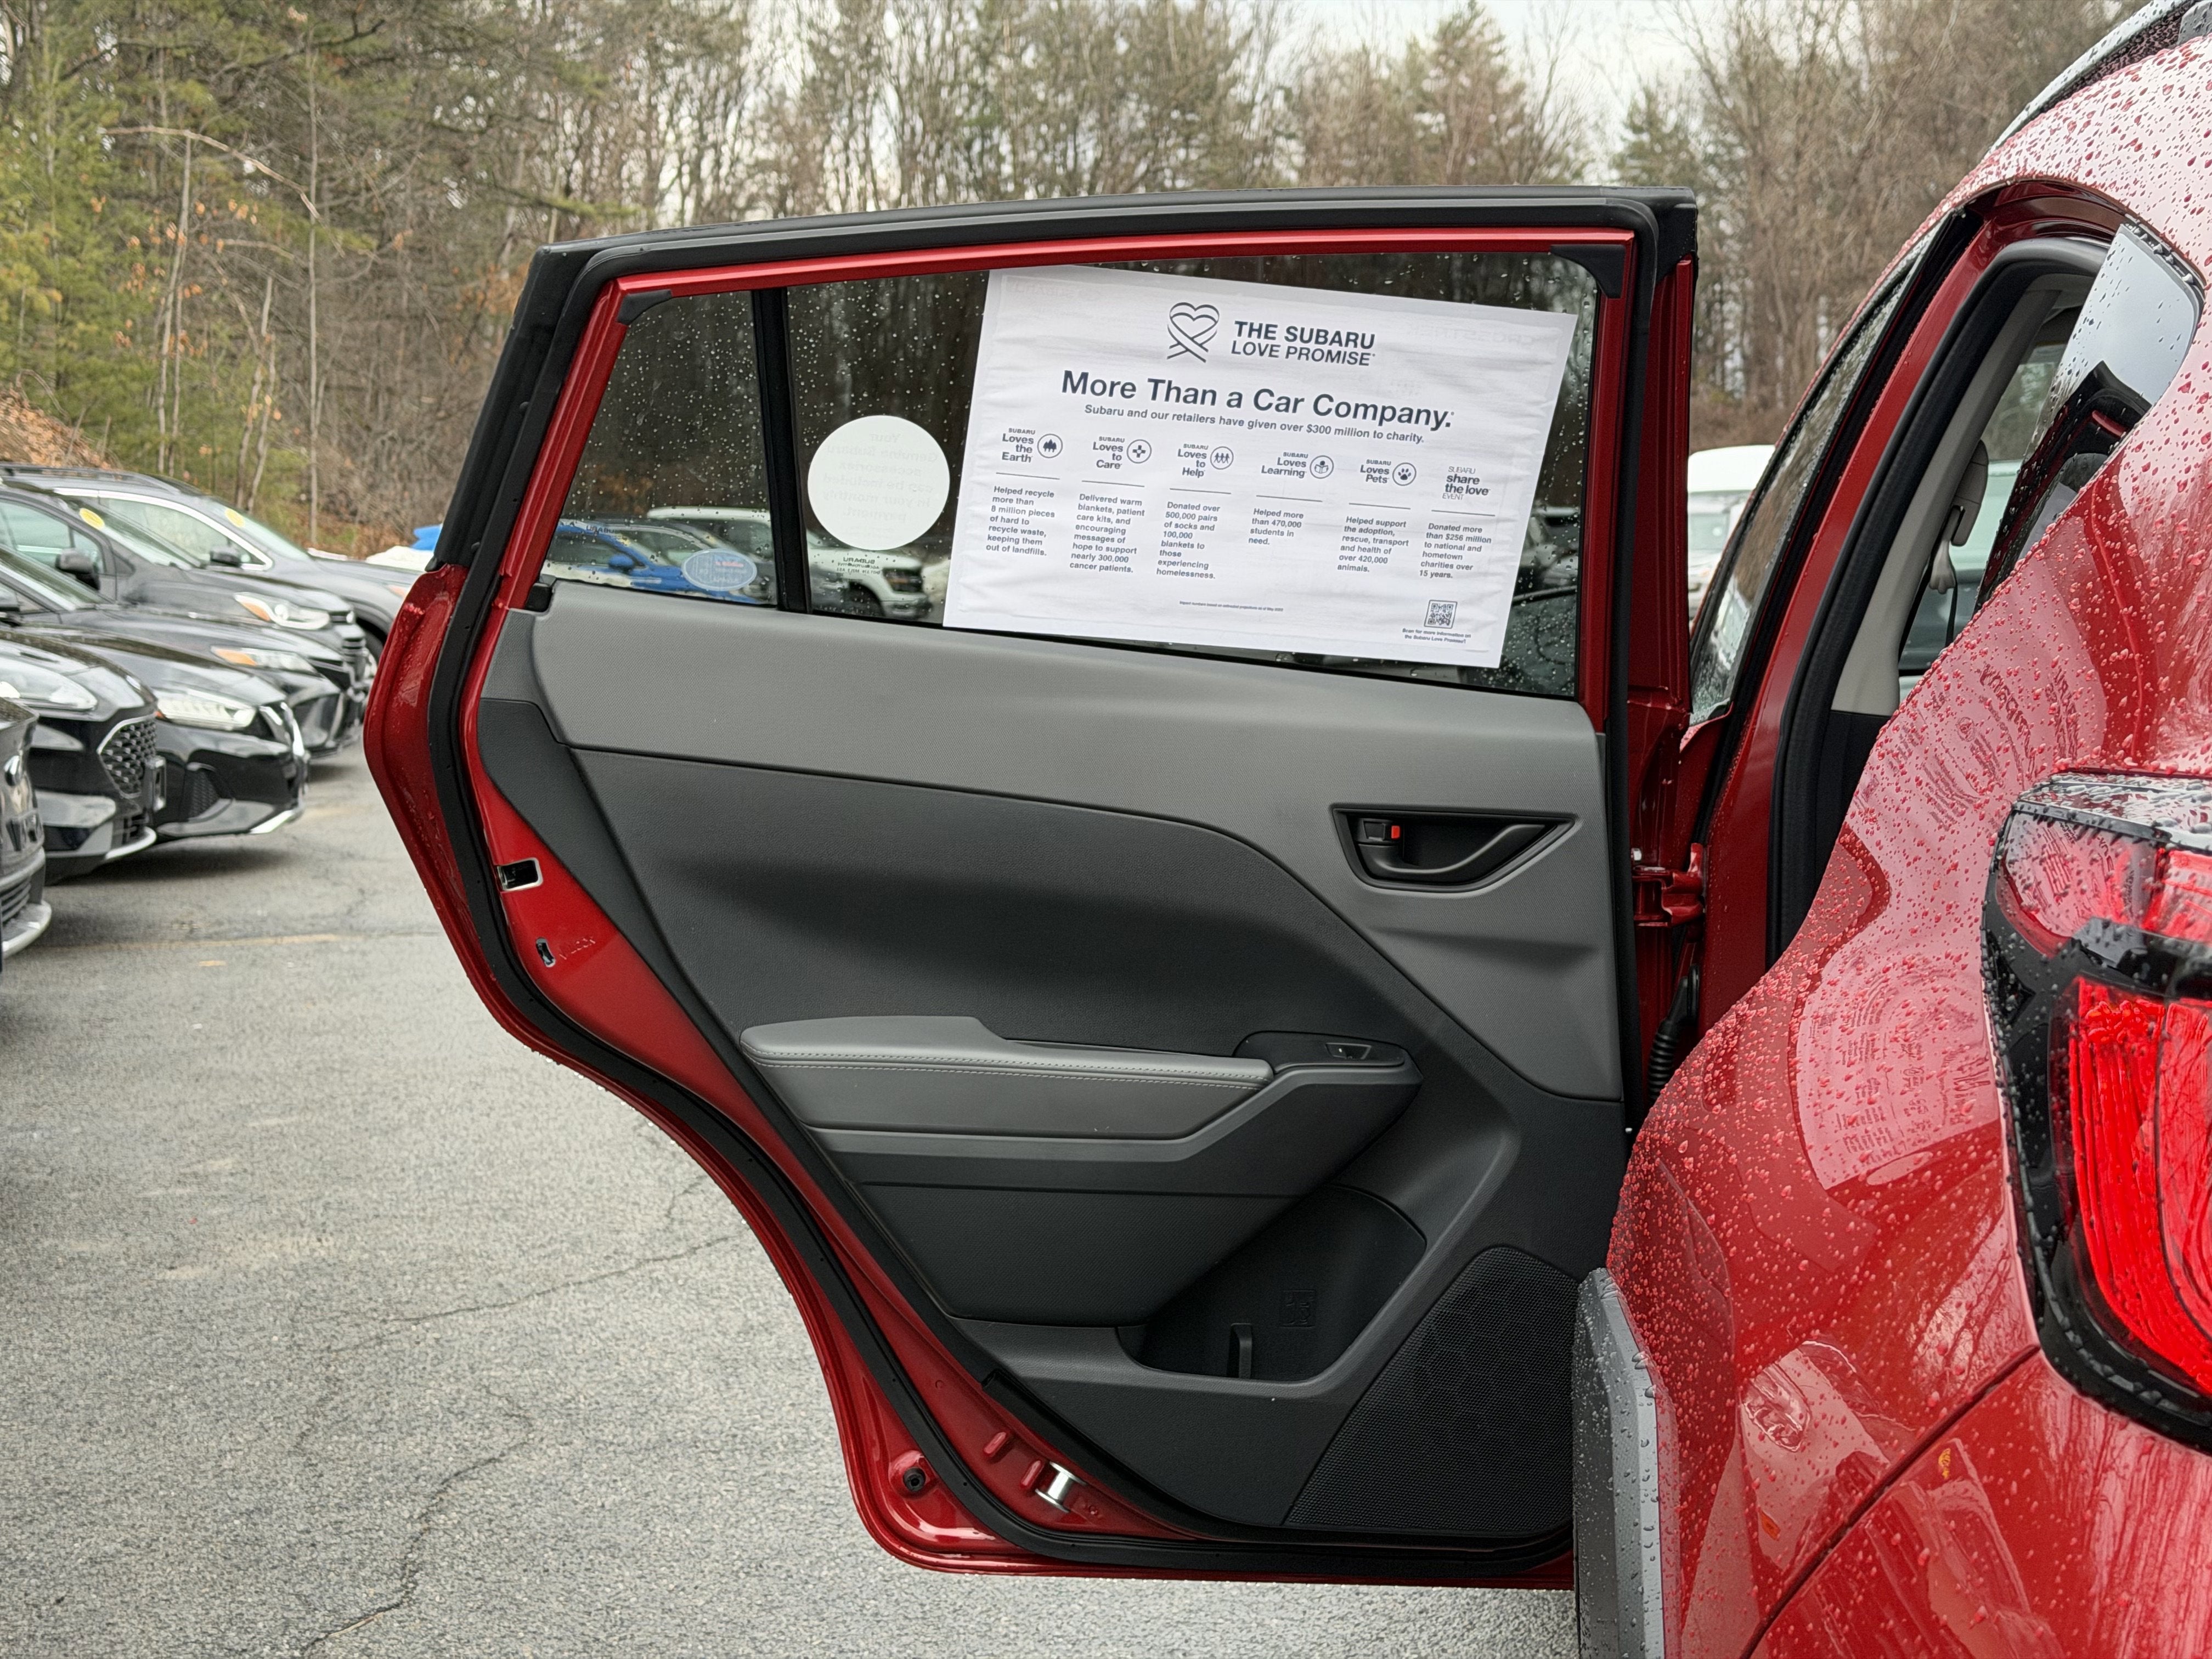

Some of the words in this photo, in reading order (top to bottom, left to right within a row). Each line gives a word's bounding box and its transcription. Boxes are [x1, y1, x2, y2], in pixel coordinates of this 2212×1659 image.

[1234, 320, 1278, 341] THE
[1284, 325, 1375, 350] SUBARU
[1231, 340, 1281, 358] LOVE
[1062, 370, 1137, 399] More
[1147, 378, 1217, 407] Than
[1226, 391, 1243, 409] a
[1253, 388, 1305, 414] Car
[1085, 404, 1124, 416] Subaru
[1127, 409, 1148, 419] and
[1150, 411, 1170, 420] our
[1172, 413, 1216, 424] retailers
[1218, 415, 1245, 427] have
[1247, 419, 1277, 430] given
[1279, 424, 1304, 432] over
[1306, 424, 1332, 435] $300
[1334, 427, 1370, 438] million
[1373, 430, 1384, 439] to
[1386, 431, 1424, 445] charity.
[1002, 433, 1034, 445] Loves
[1015, 444, 1033, 454] the
[1092, 441, 1124, 453] Loves
[1002, 452, 1033, 463] Earth
[1112, 453, 1122, 461] to
[1177, 448, 1207, 459] Loves
[1096, 459, 1122, 470] Care
[1196, 460, 1206, 468] to
[1277, 457, 1307, 468] Loves
[1182, 467, 1204, 479] Help
[1261, 465, 1306, 479] Learning
[1360, 464, 1390, 475] Loves
[1448, 466, 1476, 475] SUBARU
[1365, 473, 1390, 484] Pets
[1446, 473, 1480, 486] share
[994, 486, 1023, 495] Helped
[1025, 490, 1054, 499] recycle
[1444, 483, 1464, 494] the
[1465, 484, 1489, 496] love
[1016, 498, 1034, 506] than
[1079, 493, 1118, 504] Delivered
[1078, 503, 1114, 515] blankets,
[1116, 509, 1145, 517] patient
[1167, 501, 1201, 511] Donated
[998, 507, 1026, 515] million
[1028, 509, 1055, 518] pieces
[1165, 511, 1196, 520] 500,000
[1253, 508, 1282, 518] Helped
[1000, 516, 1019, 524] hard
[1097, 515, 1113, 524] kits,
[1252, 517, 1269, 526] than
[1271, 520, 1302, 528] 470,000
[1346, 516, 1374, 526] Helped
[1375, 520, 1407, 528] support
[989, 526, 1018, 534] recycle
[1020, 529, 1047, 538] waste,
[1075, 524, 1126, 536] encouraging
[1250, 527, 1284, 537] students
[1358, 527, 1395, 537] adoption,
[1428, 522, 1462, 532] Donated
[987, 534, 1020, 545] keeping
[1022, 537, 1043, 546] them
[1074, 534, 1115, 544] messages
[1164, 531, 1193, 539] 100,000
[1426, 532, 1443, 540] than
[1445, 533, 1464, 541] $256
[1465, 535, 1492, 544] million
[1161, 540, 1194, 549] blankets
[1342, 535, 1370, 544] rescue,
[1373, 537, 1409, 547] transport
[1012, 546, 1047, 556] landfills.
[1073, 542, 1093, 552] hope
[1105, 546, 1137, 555] support
[1357, 545, 1381, 554] health
[1434, 543, 1466, 551] national
[1071, 553, 1096, 562] nearly
[1098, 554, 1129, 563] 300,000
[1159, 549, 1182, 557] those
[1422, 551, 1463, 560] hometown
[1158, 560, 1209, 571] experiencing
[1358, 555, 1388, 565] 420,000
[1420, 560, 1454, 569] charities
[1099, 565, 1133, 573] patients.
[1156, 568, 1215, 579] homelessness.
[1337, 564, 1370, 572] animals.
